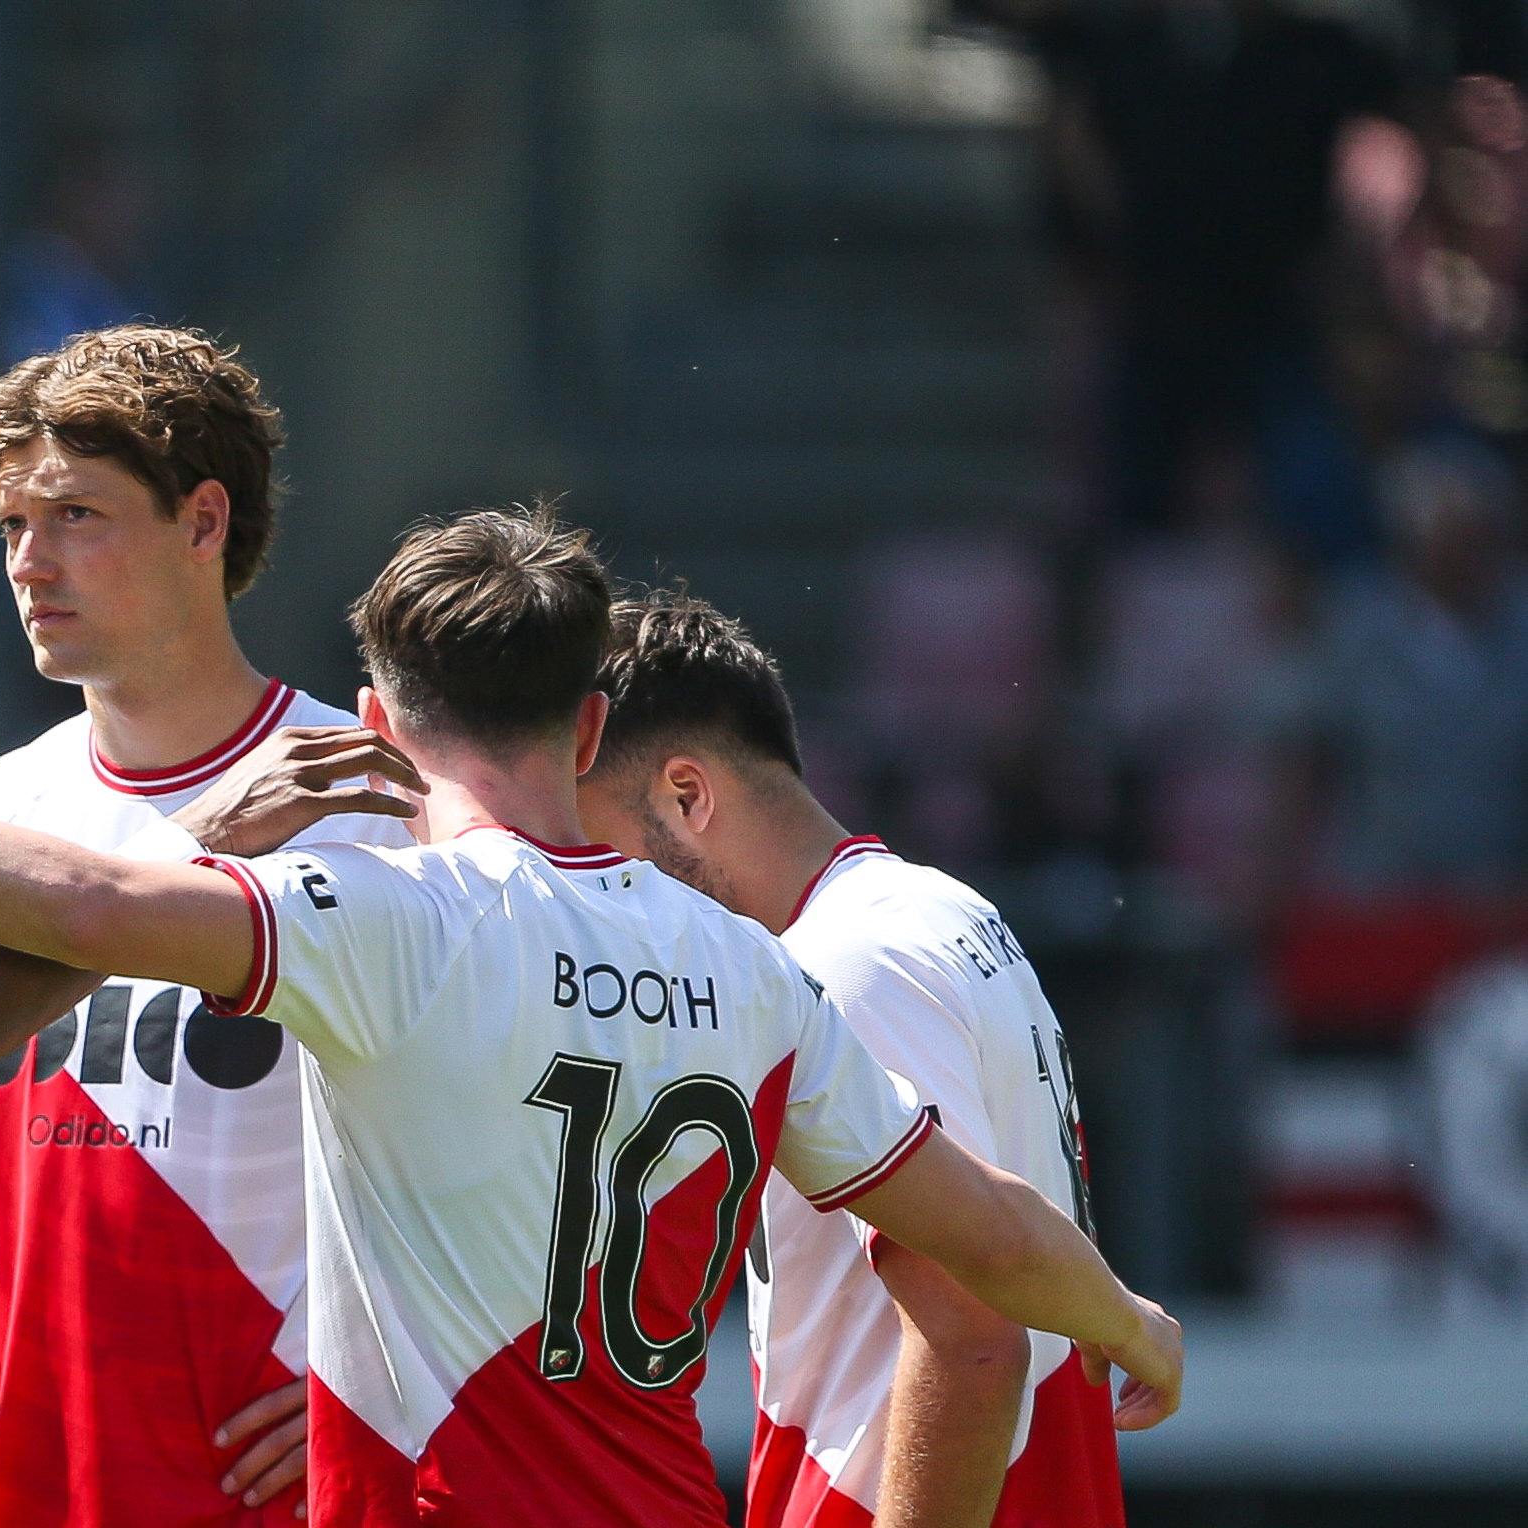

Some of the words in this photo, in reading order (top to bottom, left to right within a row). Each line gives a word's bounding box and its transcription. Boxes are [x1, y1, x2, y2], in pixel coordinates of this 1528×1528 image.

[553, 951, 719, 1030] BOOTH
[27, 1115, 172, 1149] Odido.nl
[523, 1051, 760, 1390] 10
